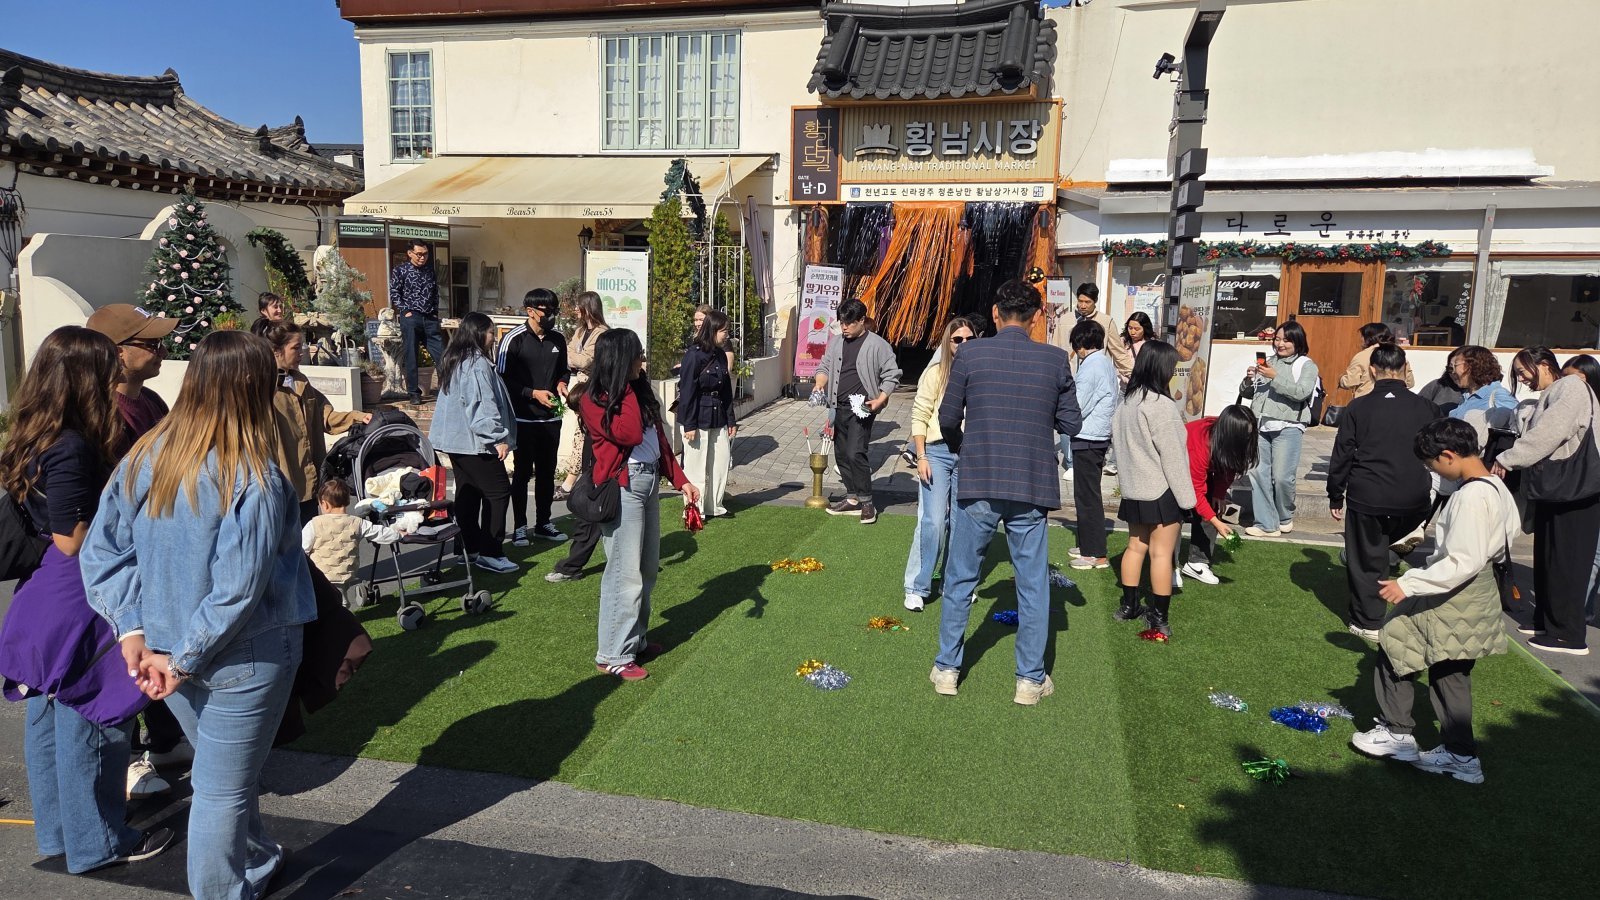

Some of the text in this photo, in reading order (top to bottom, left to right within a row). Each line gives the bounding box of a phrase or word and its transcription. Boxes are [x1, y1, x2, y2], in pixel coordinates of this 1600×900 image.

[905, 119, 1041, 156] 황남시장
[861, 160, 1037, 171] HWANG-NAM TRADITIONAL MARKET
[802, 181, 827, 195] 남-D
[865, 188, 897, 197] 천년고도
[901, 188, 934, 197] 신라경주
[938, 187, 972, 197] 청춘낭만
[976, 186, 1029, 197] 황남상가시장
[360, 205, 388, 214] Bear58
[432, 206, 460, 215] Bear58
[506, 207, 537, 216] Bear58
[582, 207, 614, 216] Bear58
[342, 225, 382, 233] PHOTOBOOTH
[396, 227, 443, 238] PHOTOCOMMA
[806, 283, 840, 297] 딸기우유
[804, 297, 839, 311] 맛 집
